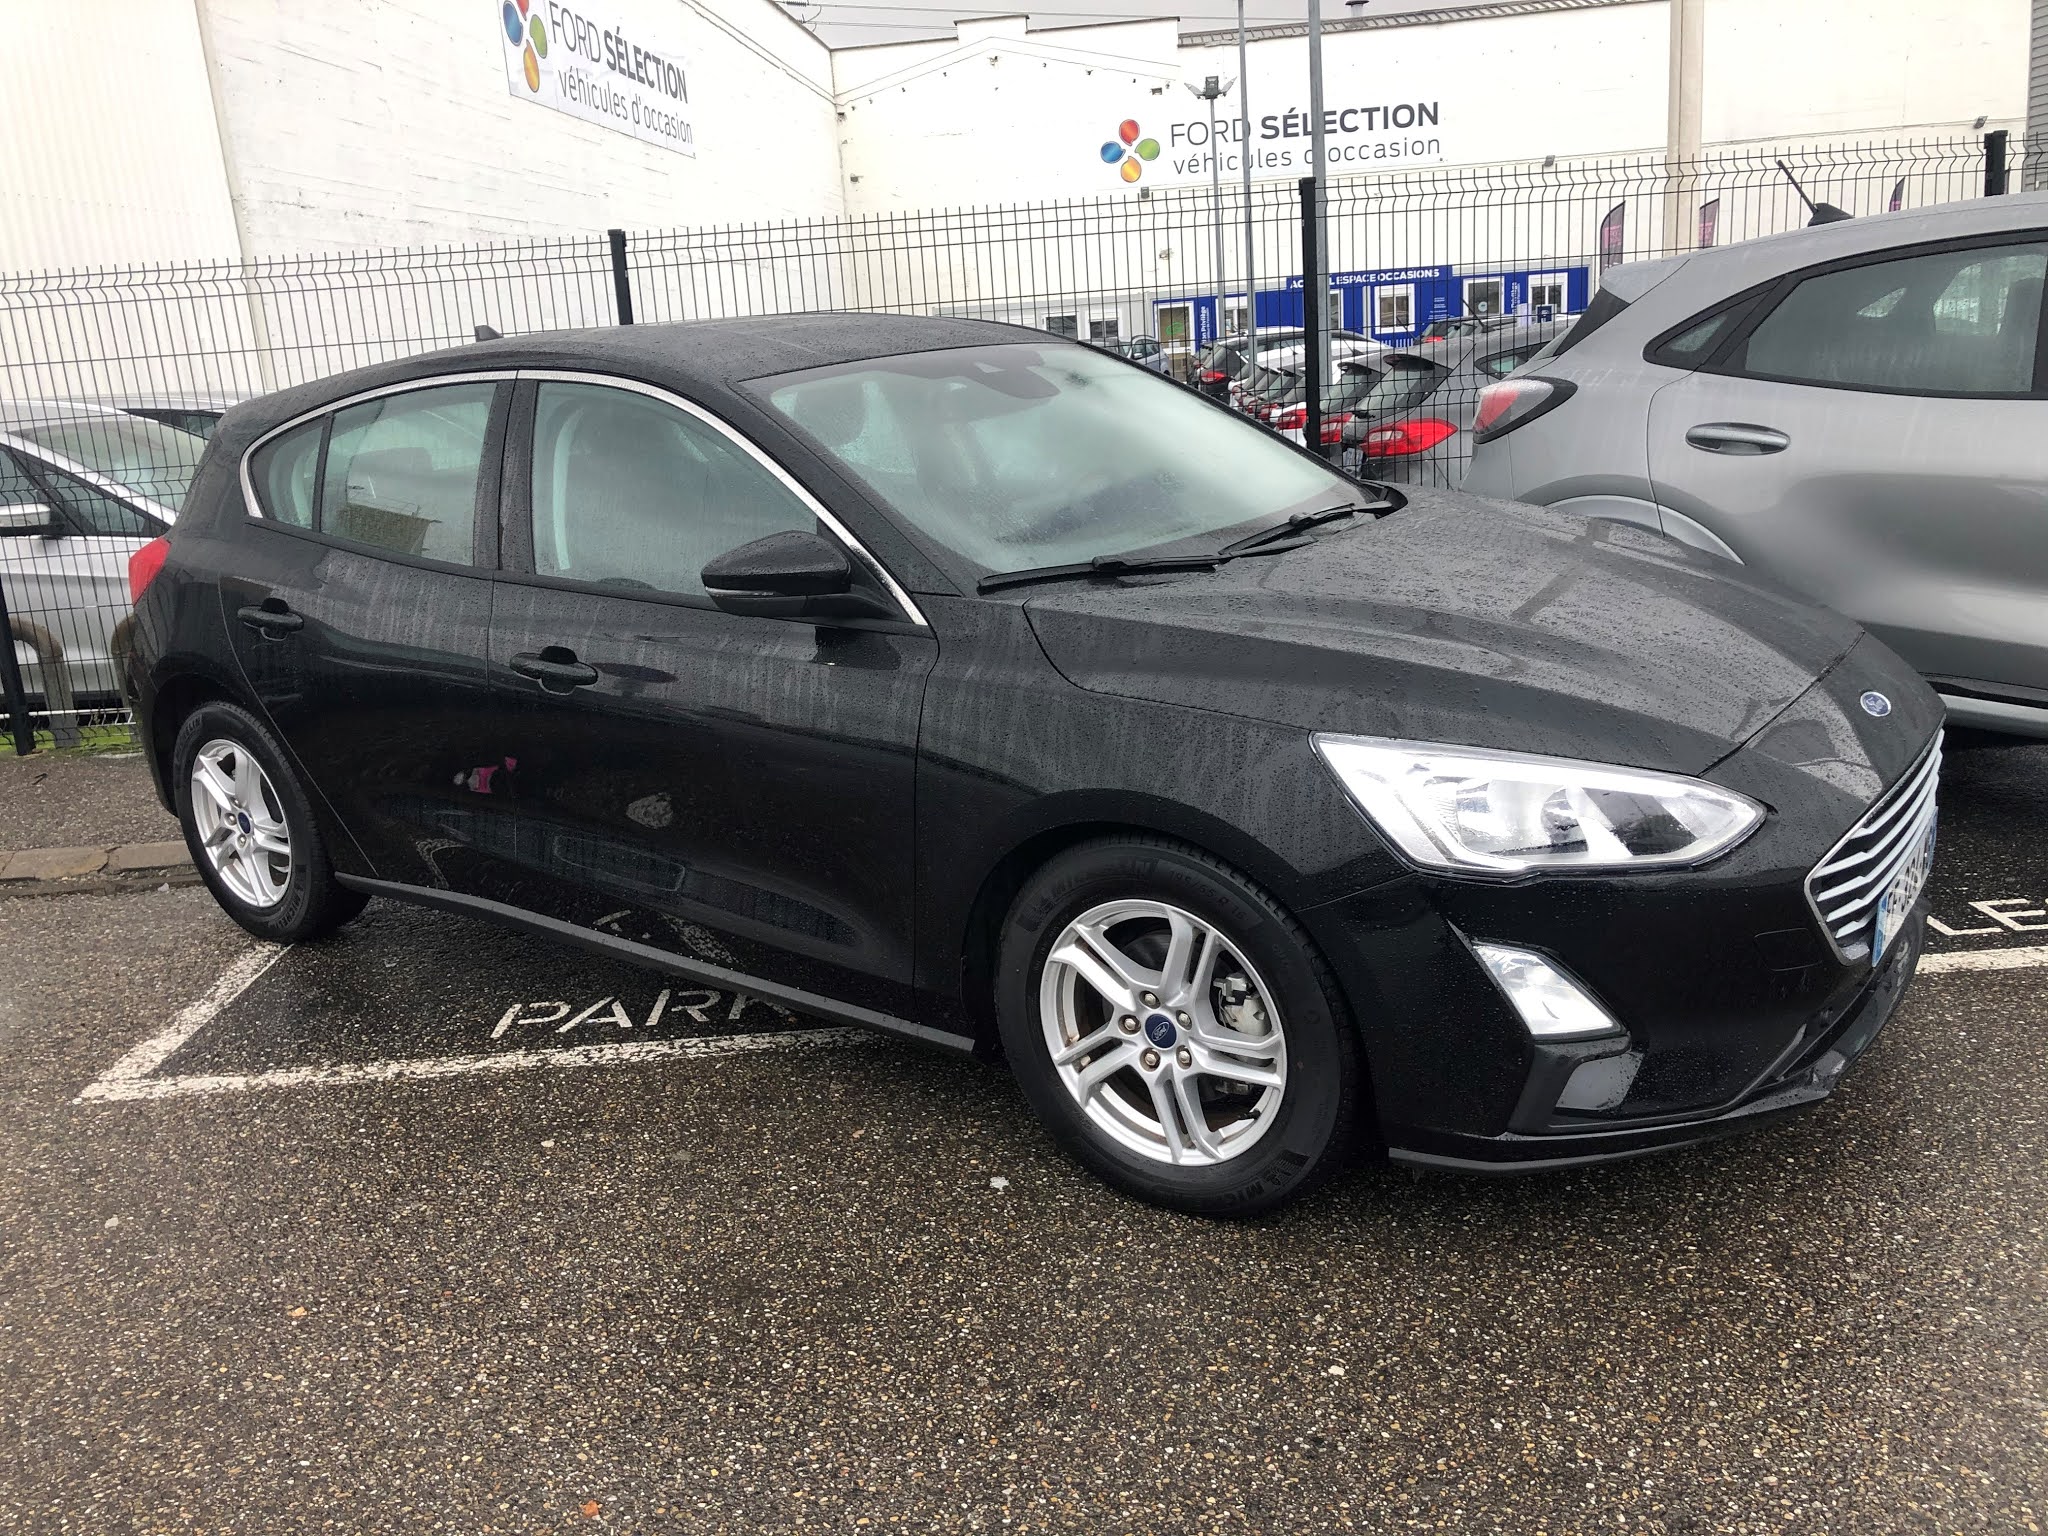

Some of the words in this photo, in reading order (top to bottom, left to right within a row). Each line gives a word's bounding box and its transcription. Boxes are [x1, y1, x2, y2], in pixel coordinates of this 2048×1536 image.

[549, 1, 601, 63] FORD
[604, 26, 689, 104] SÉLECTION
[558, 65, 628, 121] véhicules
[631, 93, 693, 144] d'occasion
[1171, 118, 1251, 147] FORD
[1260, 102, 1439, 140] SÉLECTION
[1336, 273, 1377, 285] ESPACE
[1377, 268, 1440, 282] OCCASIONS
